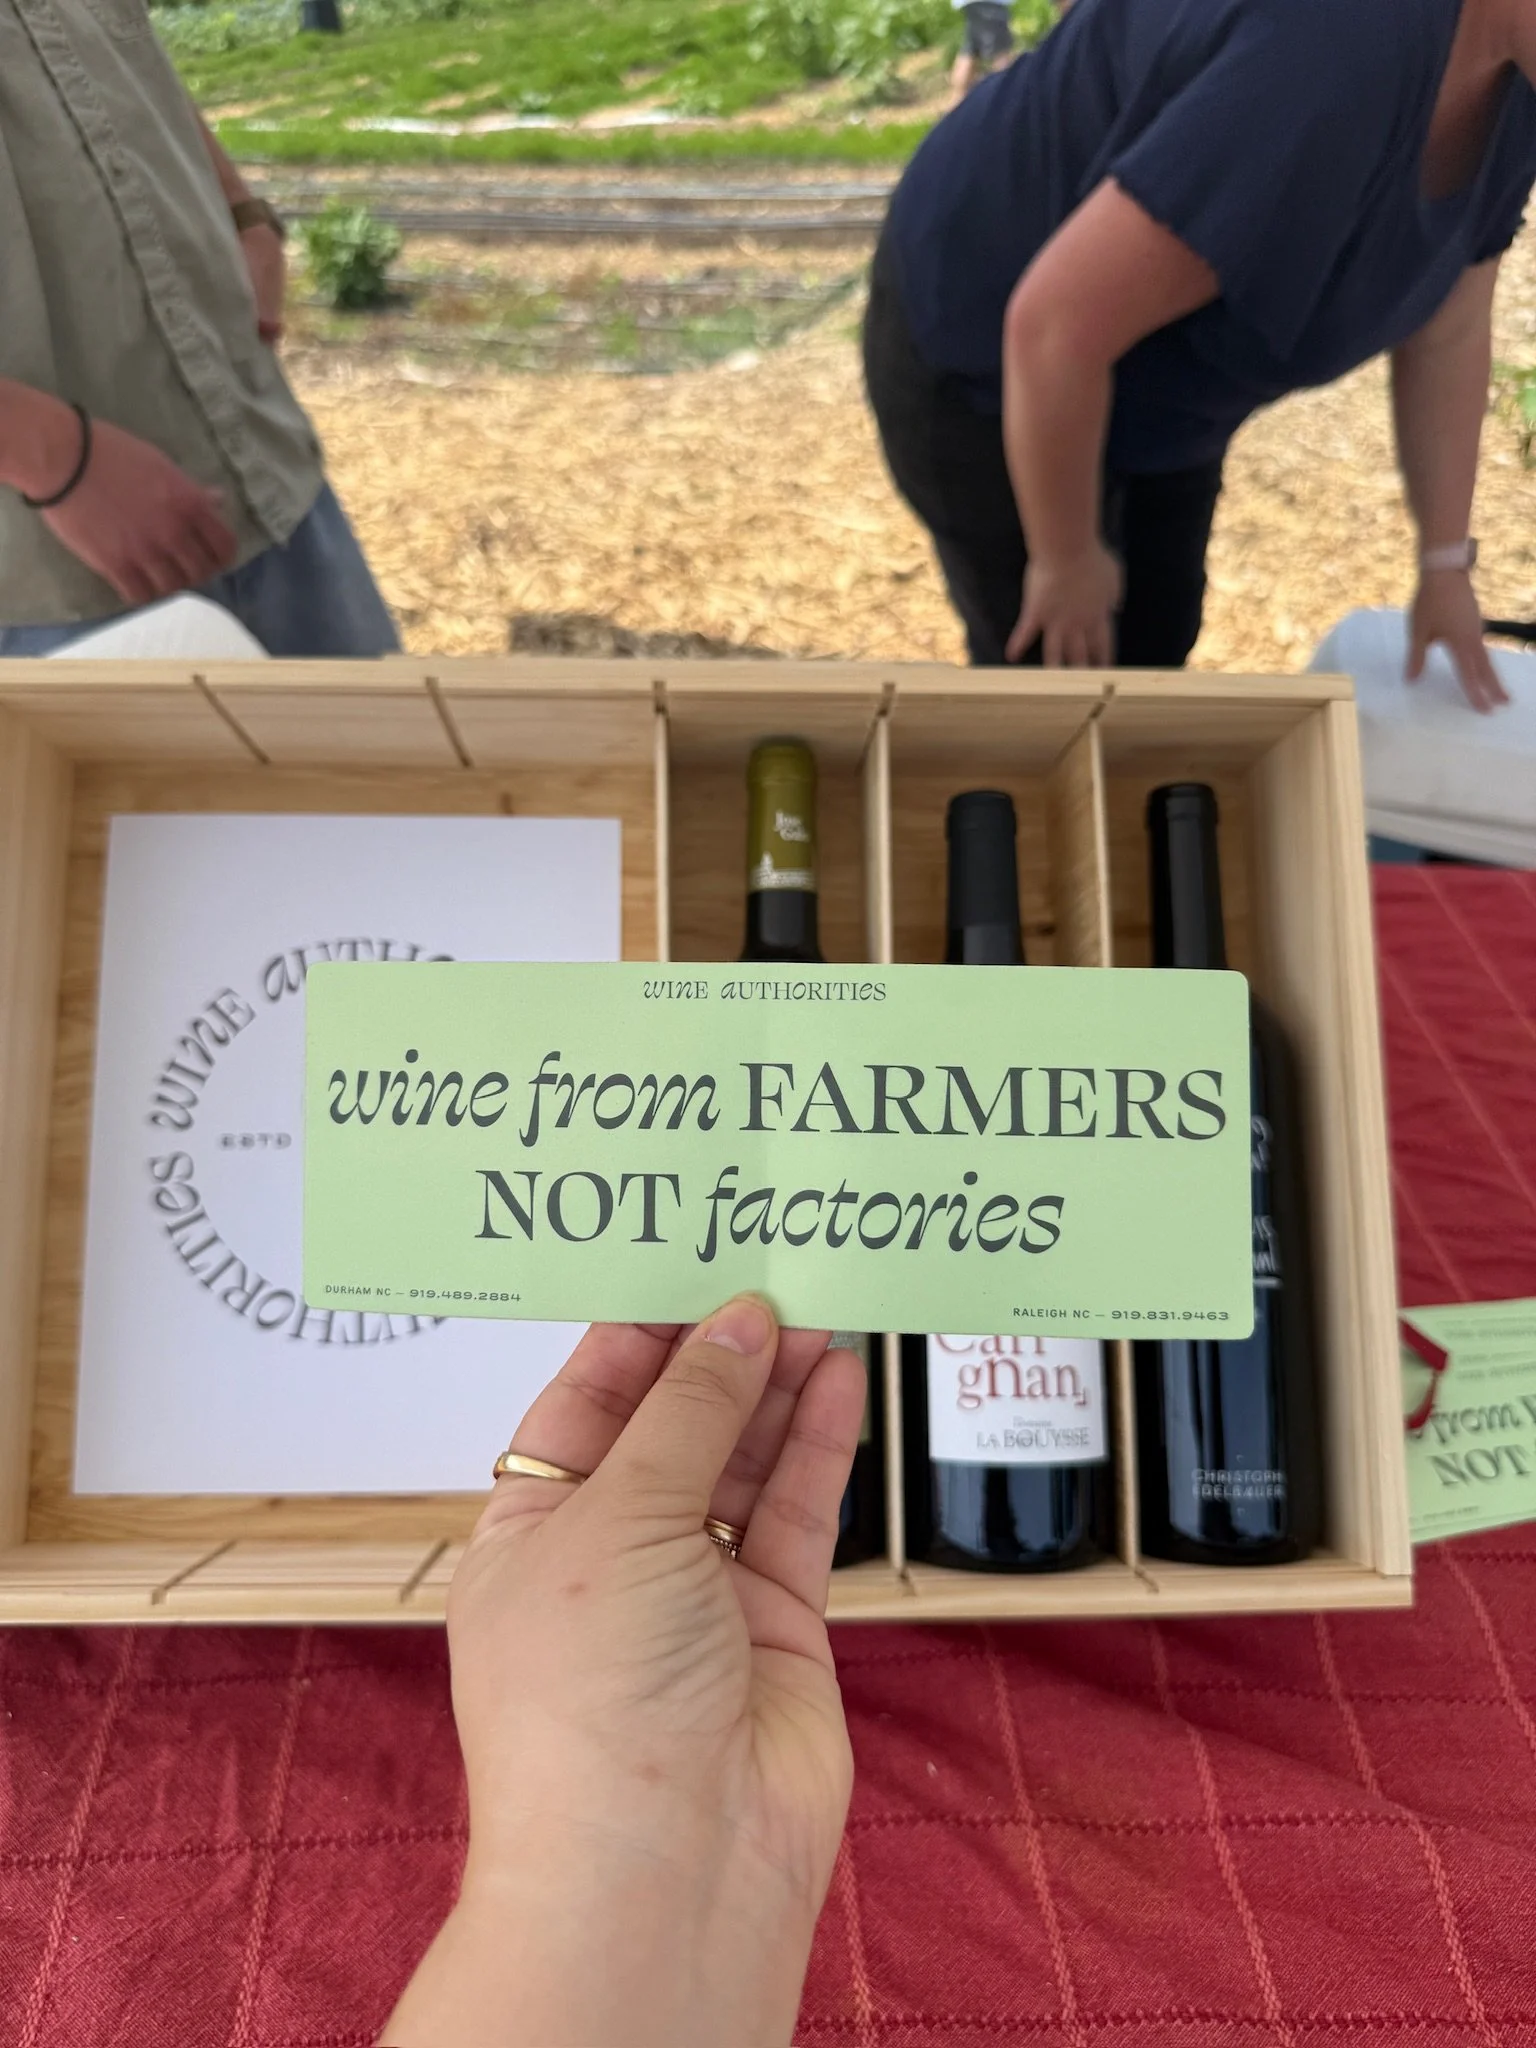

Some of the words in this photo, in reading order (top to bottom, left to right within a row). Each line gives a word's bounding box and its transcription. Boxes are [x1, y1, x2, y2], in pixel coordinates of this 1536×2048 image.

[328, 1048, 509, 1128] wine
[519, 1050, 721, 1148] from
[738, 1061, 1226, 1141] FARMERS
[474, 1170, 681, 1243] NOT
[695, 1165, 1065, 1263] factories
[325, 1284, 372, 1297] DURHAM
[376, 1286, 391, 1297] NC
[409, 1288, 521, 1302] 919.489.2884
[1013, 1307, 1067, 1319] RALEIGH
[1072, 1308, 1090, 1319] NC
[1111, 1309, 1229, 1321] 919.831.9463
[1427, 1444, 1531, 1486] NOT
